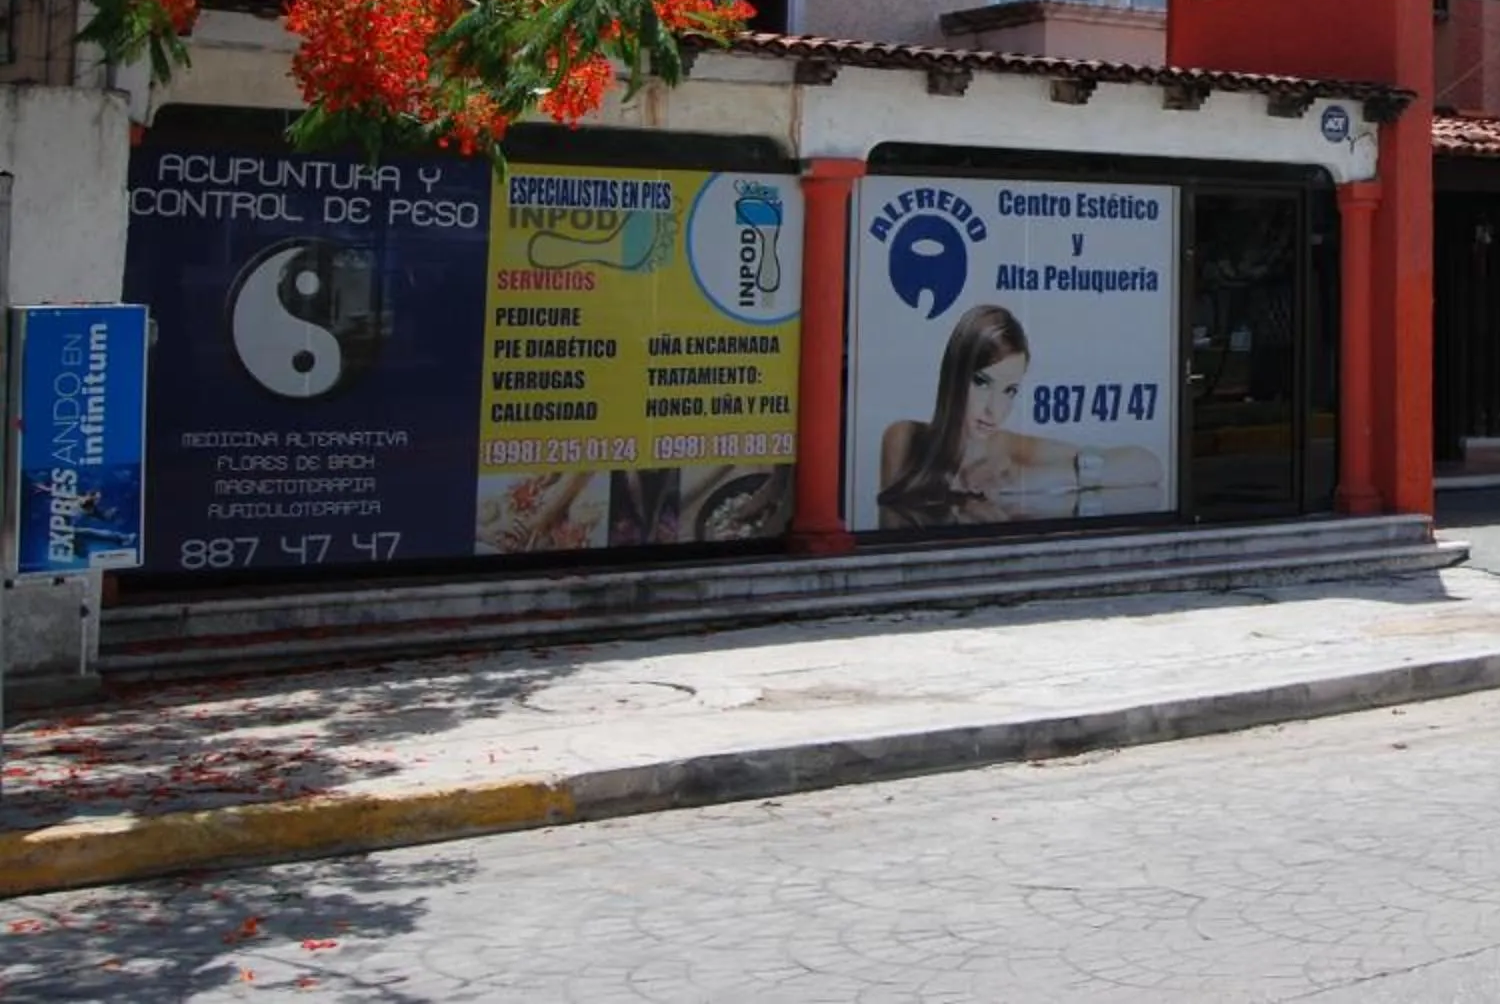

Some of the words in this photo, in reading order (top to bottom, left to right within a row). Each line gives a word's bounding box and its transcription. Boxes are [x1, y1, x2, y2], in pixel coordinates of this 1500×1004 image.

[158, 153, 401, 192] ACUPUNTURA
[418, 168, 442, 193] Y
[510, 176, 618, 209] ESPECIALISTAS
[621, 181, 639, 209] EN
[642, 182, 671, 210] PIES
[998, 190, 1071, 217] Centro
[1076, 193, 1159, 220] Estético
[130, 187, 303, 222] CONTROL
[323, 197, 371, 225] DE
[388, 199, 480, 228] PESO
[509, 207, 619, 231] INPOD
[869, 188, 987, 243] ALFREDO
[1071, 233, 1084, 256] y
[739, 227, 757, 307] INPOD
[996, 265, 1039, 292] Alta
[497, 269, 596, 292] SERVICIOS
[495, 307, 582, 327] PEDICURE
[60, 333, 84, 367] EN
[493, 340, 522, 359] PIE
[525, 335, 617, 359] DIABÉTICO
[648, 333, 682, 356] UÑA
[686, 335, 781, 355] ENCARNADA
[492, 370, 586, 391] VERRUGAS
[648, 366, 763, 387] TRATAMIENTO:
[78, 322, 109, 466] infinitum
[711, 393, 744, 416] UÑA
[748, 396, 756, 414] Y
[759, 395, 790, 415] PIEL
[1033, 385, 1085, 424] 887
[1091, 383, 1122, 422] 47
[1128, 383, 1158, 421] 47
[491, 401, 598, 423] CALLOSIDAD
[181, 431, 278, 448] MEDICINA
[286, 430, 409, 447] ALTERNATIVA
[547, 438, 582, 463] 215
[612, 437, 637, 461] 24
[217, 455, 288, 471] FLORES
[296, 455, 321, 471] DE
[214, 477, 377, 495] MAGNETOTERAPIA
[207, 500, 382, 519] AURICULOTERAPIA
[181, 537, 260, 569] 887
[280, 534, 332, 564] 47
[352, 531, 401, 561] 47
